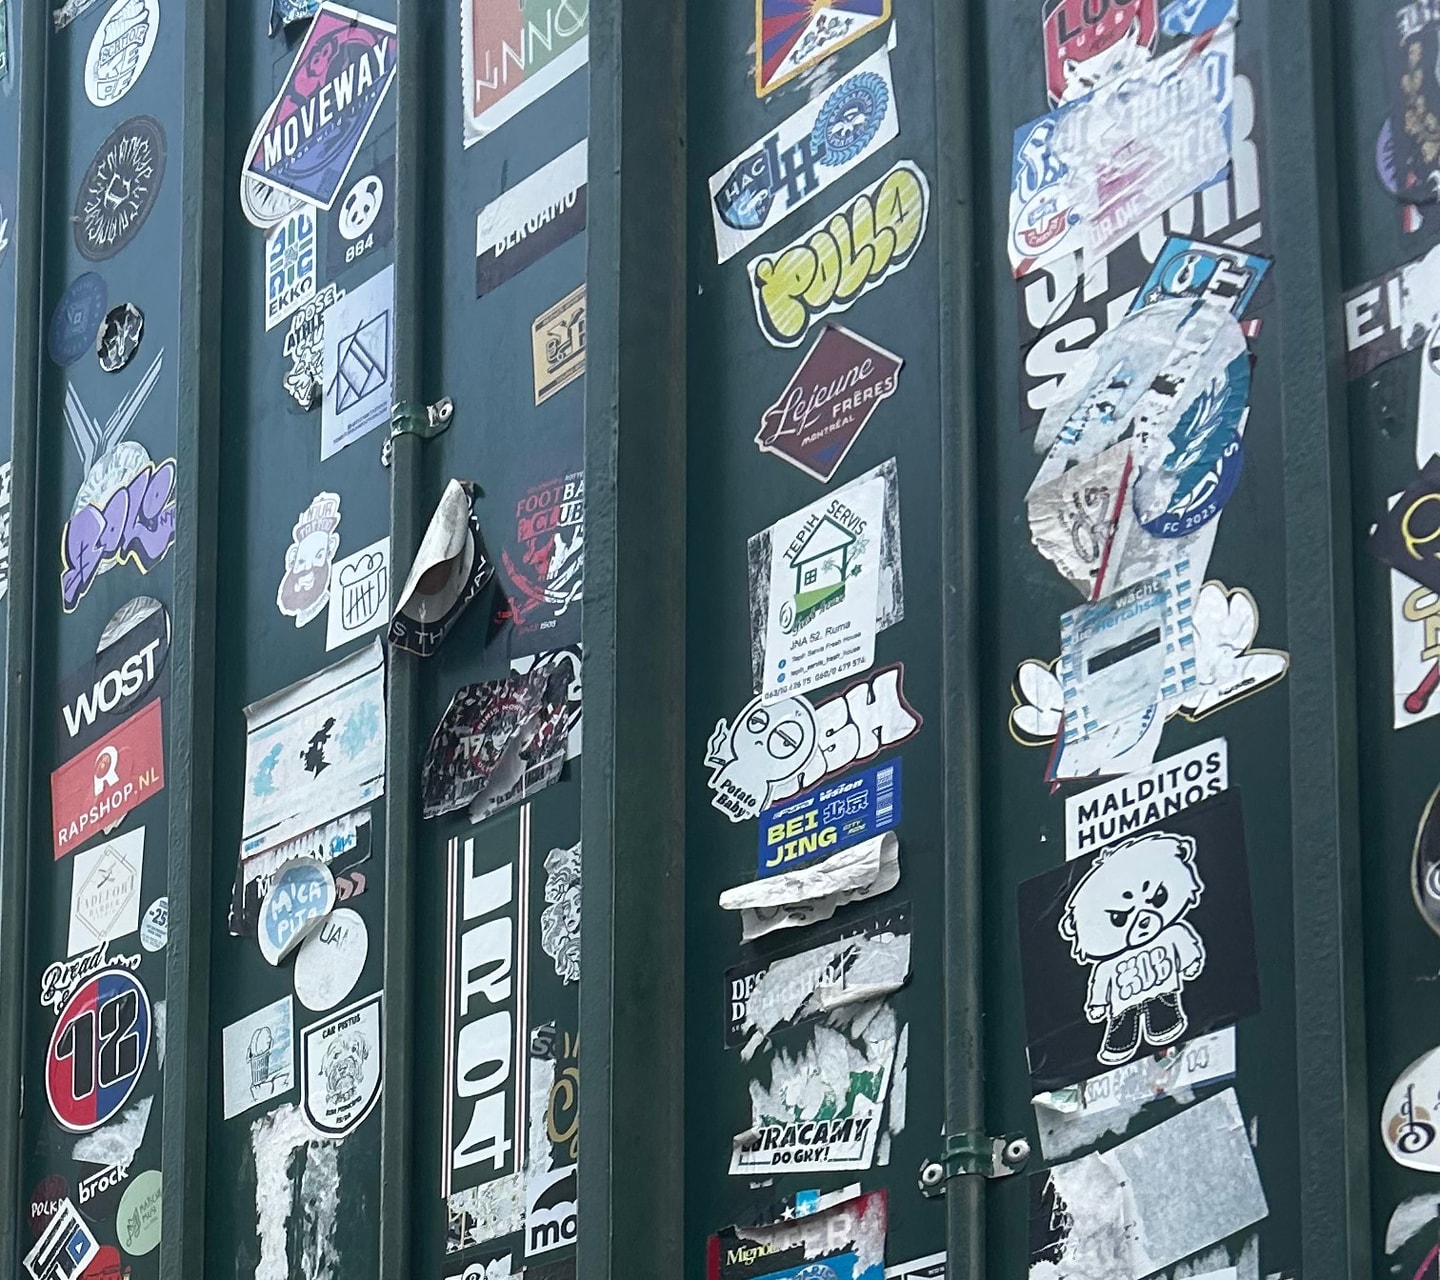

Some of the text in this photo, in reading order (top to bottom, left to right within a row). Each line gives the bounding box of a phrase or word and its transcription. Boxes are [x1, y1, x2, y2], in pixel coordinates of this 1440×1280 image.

[263, 35, 390, 172] MOVEWAY
[345, 235, 375, 264] 884
[269, 277, 312, 317] EKKO
[763, 358, 876, 446] Lejeune
[831, 376, 895, 418] FRÈRES
[800, 414, 856, 447] MONTRÉAL
[782, 513, 820, 561] TEPIH
[826, 500, 868, 537] SERVIS
[1162, 504, 1216, 533] FC 2023
[61, 637, 161, 738] WOST
[58, 763, 160, 847] RAPSHOP.NL
[716, 792, 746, 819] Baby
[719, 778, 758, 808] Potato
[1078, 750, 1222, 823] MALDITOS
[766, 809, 820, 847] BEI
[1077, 778, 1224, 850] HUMANOS
[765, 825, 838, 869] JING
[771, 1146, 830, 1166] DO GRY!
[78, 1164, 129, 1204] brock
